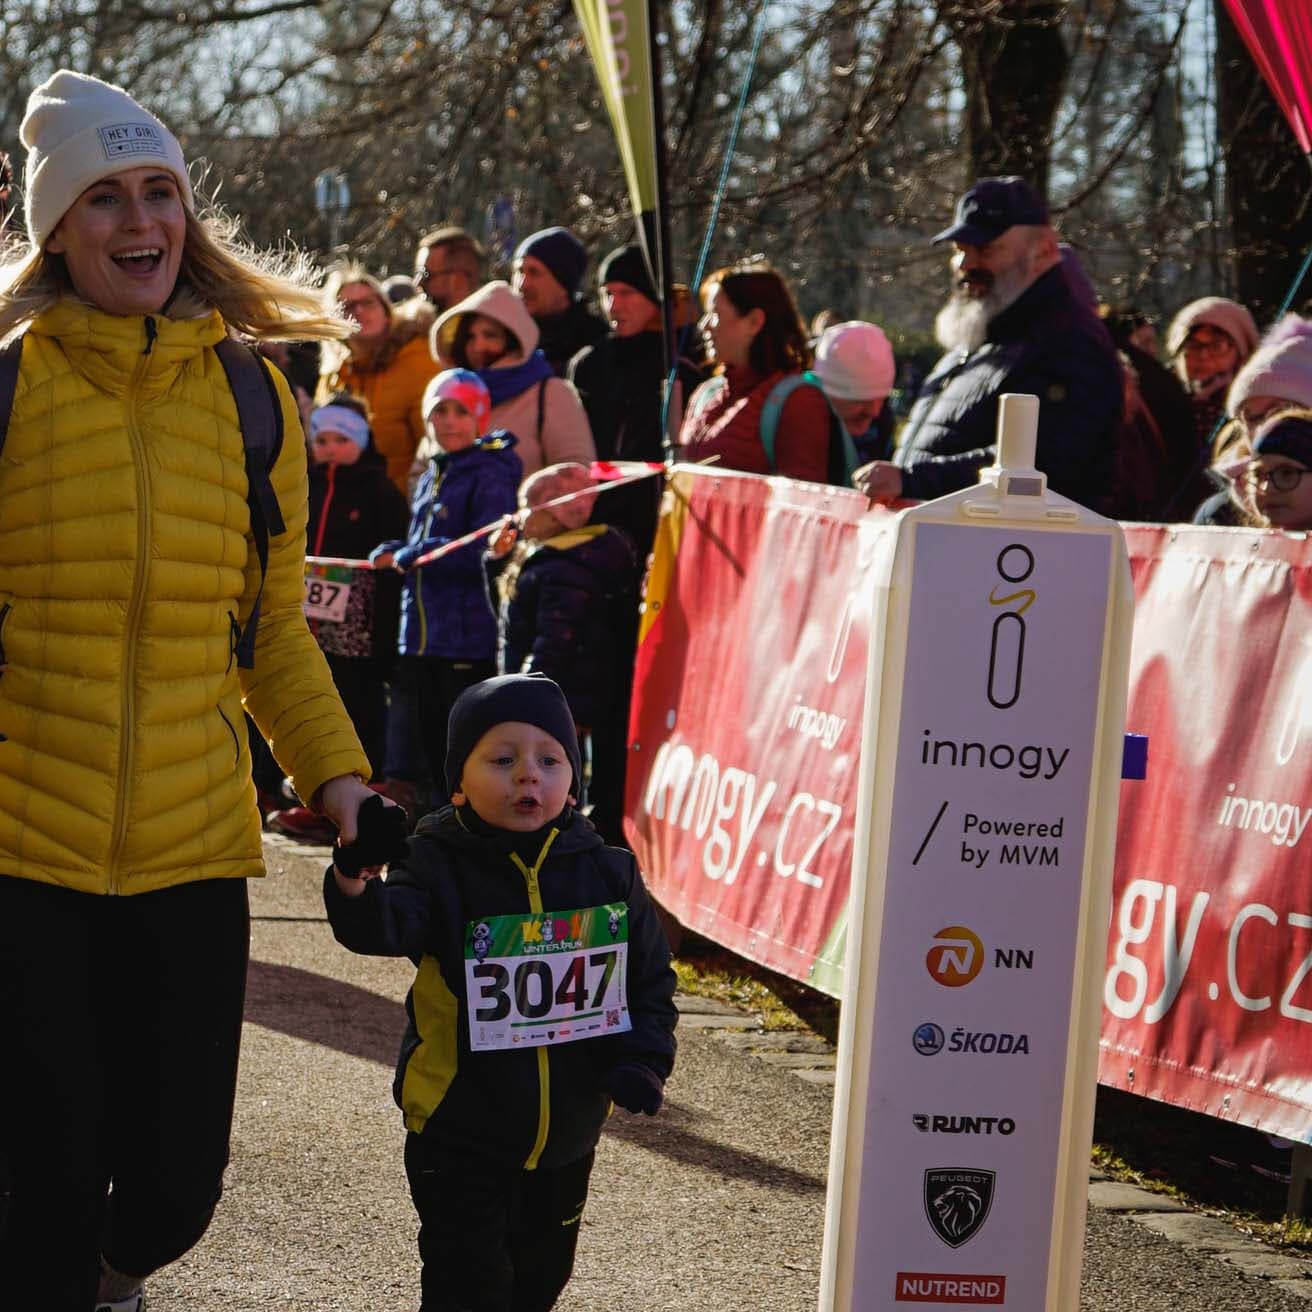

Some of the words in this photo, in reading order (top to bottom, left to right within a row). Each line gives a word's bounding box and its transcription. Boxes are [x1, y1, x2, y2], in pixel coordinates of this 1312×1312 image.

[108, 128, 128, 141] HEY
[305, 581, 341, 607] 87
[920, 729, 1070, 780] innogy
[963, 813, 1064, 839] Powered
[1218, 783, 1312, 848] innogy
[960, 841, 990, 869] by
[999, 844, 1059, 867] MVM
[994, 948, 1034, 969] NN
[1105, 879, 1312, 1025] gy.cz
[472, 950, 618, 1022] 3047
[948, 1028, 1030, 1055] ŠKODA
[932, 1115, 1016, 1135] RUNTO
[931, 1174, 989, 1185] PEUGEOT
[902, 1279, 1001, 1298] NUTREND
